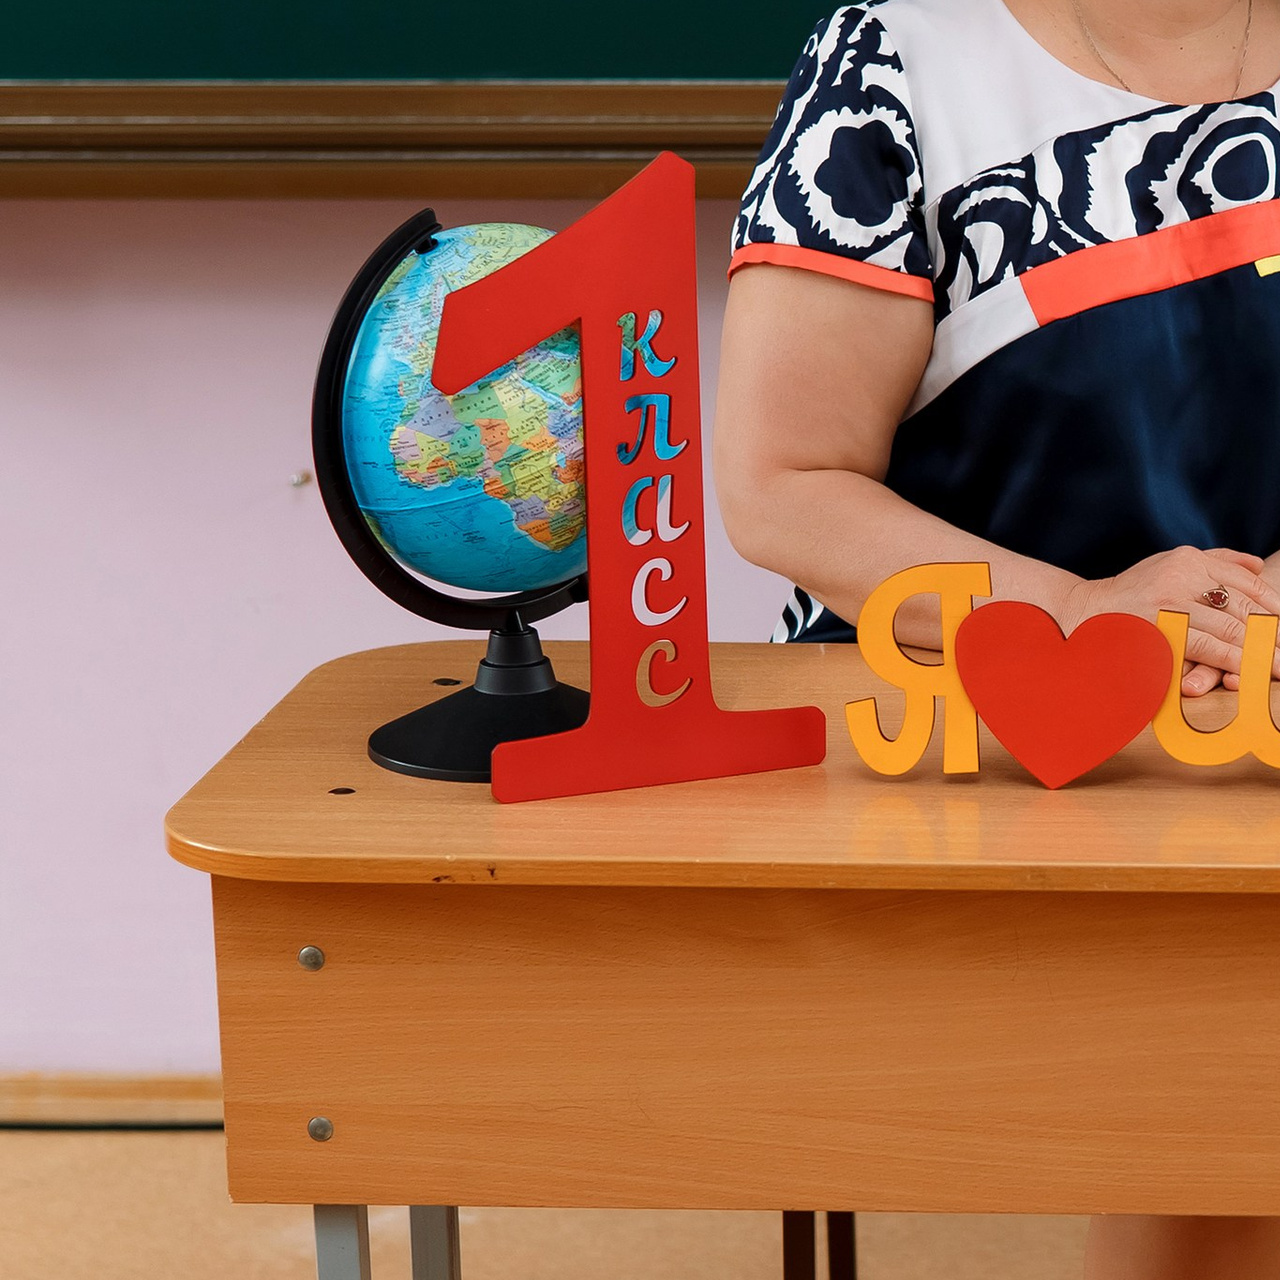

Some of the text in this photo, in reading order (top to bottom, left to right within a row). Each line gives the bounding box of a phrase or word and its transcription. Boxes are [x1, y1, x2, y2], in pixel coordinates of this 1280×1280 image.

[432, 150, 826, 804] 1
[616, 308, 693, 708] класс
[845, 561, 993, 776] Я
